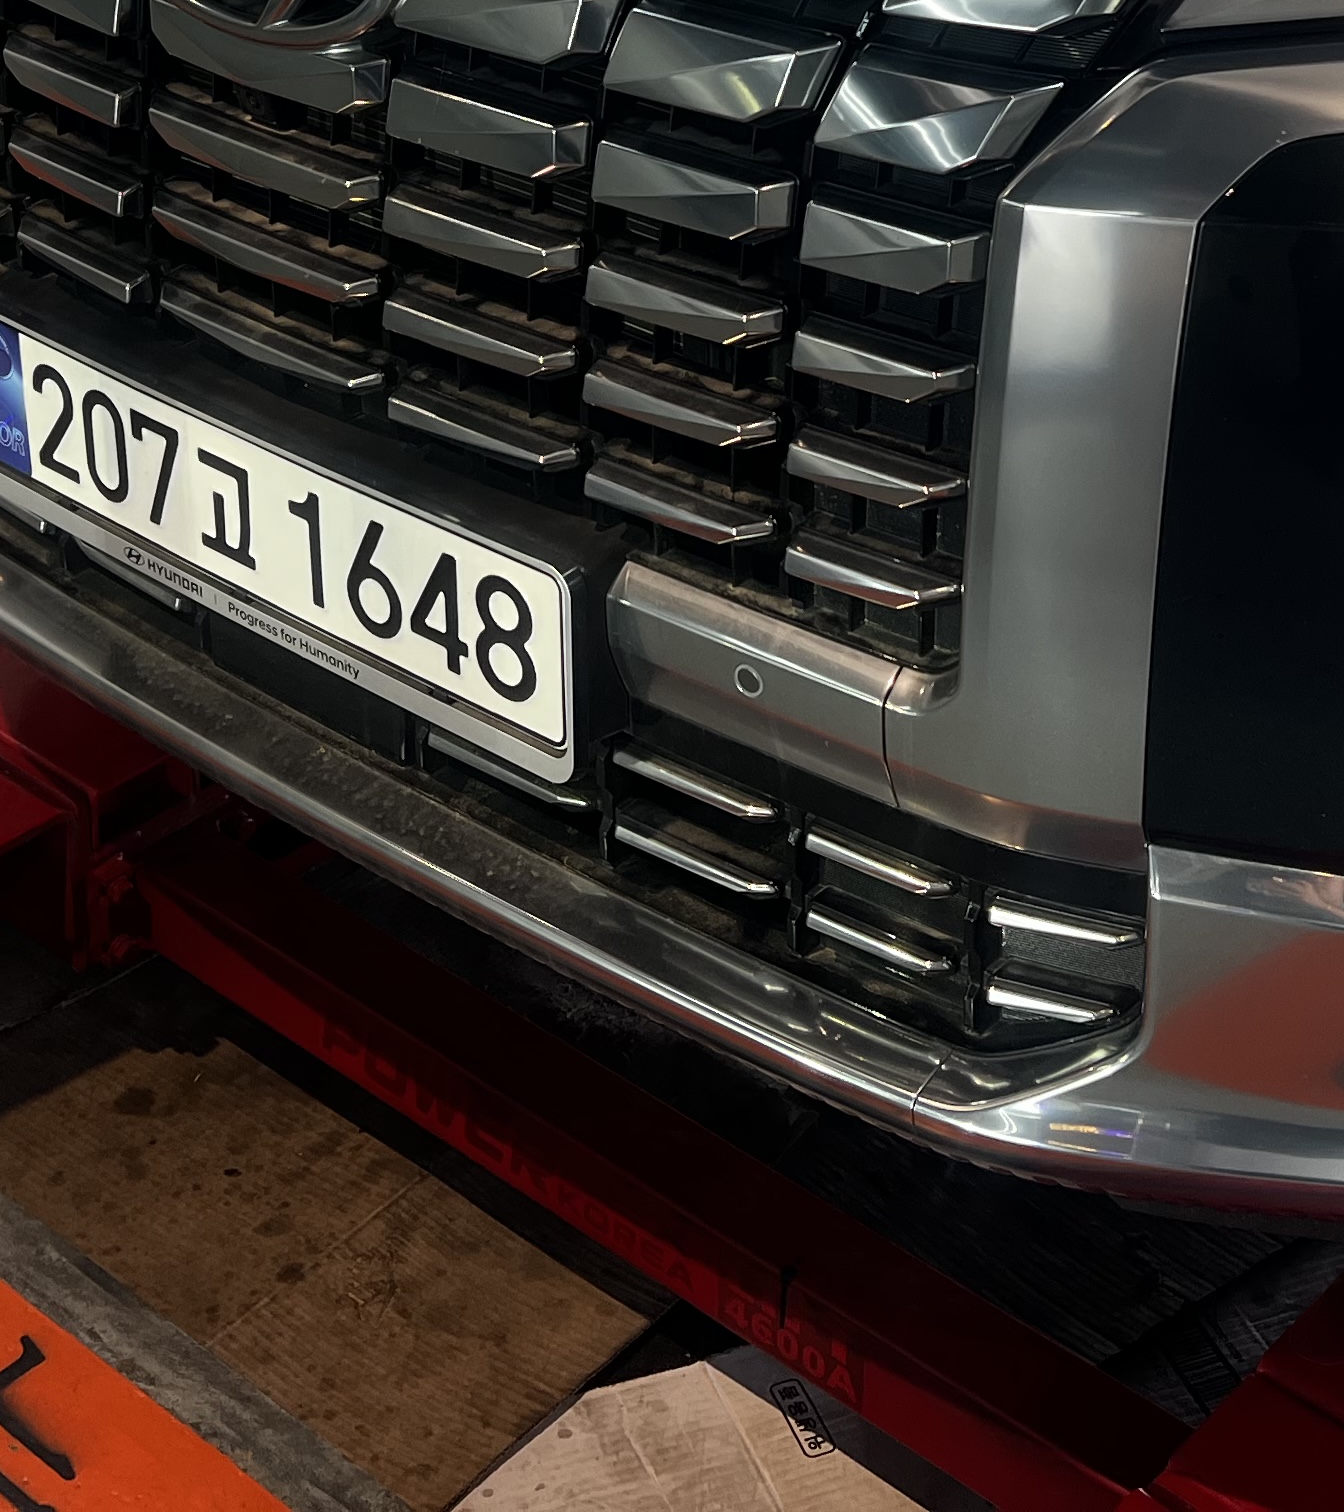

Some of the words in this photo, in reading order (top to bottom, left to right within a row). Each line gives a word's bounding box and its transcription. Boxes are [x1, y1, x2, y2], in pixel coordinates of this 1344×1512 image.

[32, 362, 256, 571] 207고
[288, 492, 537, 702] 1648
[147, 558, 203, 598] HYUNDAI
[228, 601, 278, 637] Progress
[280, 627, 297, 647] for
[299, 637, 360, 679] Humanity
[724, 1298, 858, 1404] 4600A
[777, 1385, 826, 1450] 위생용품
